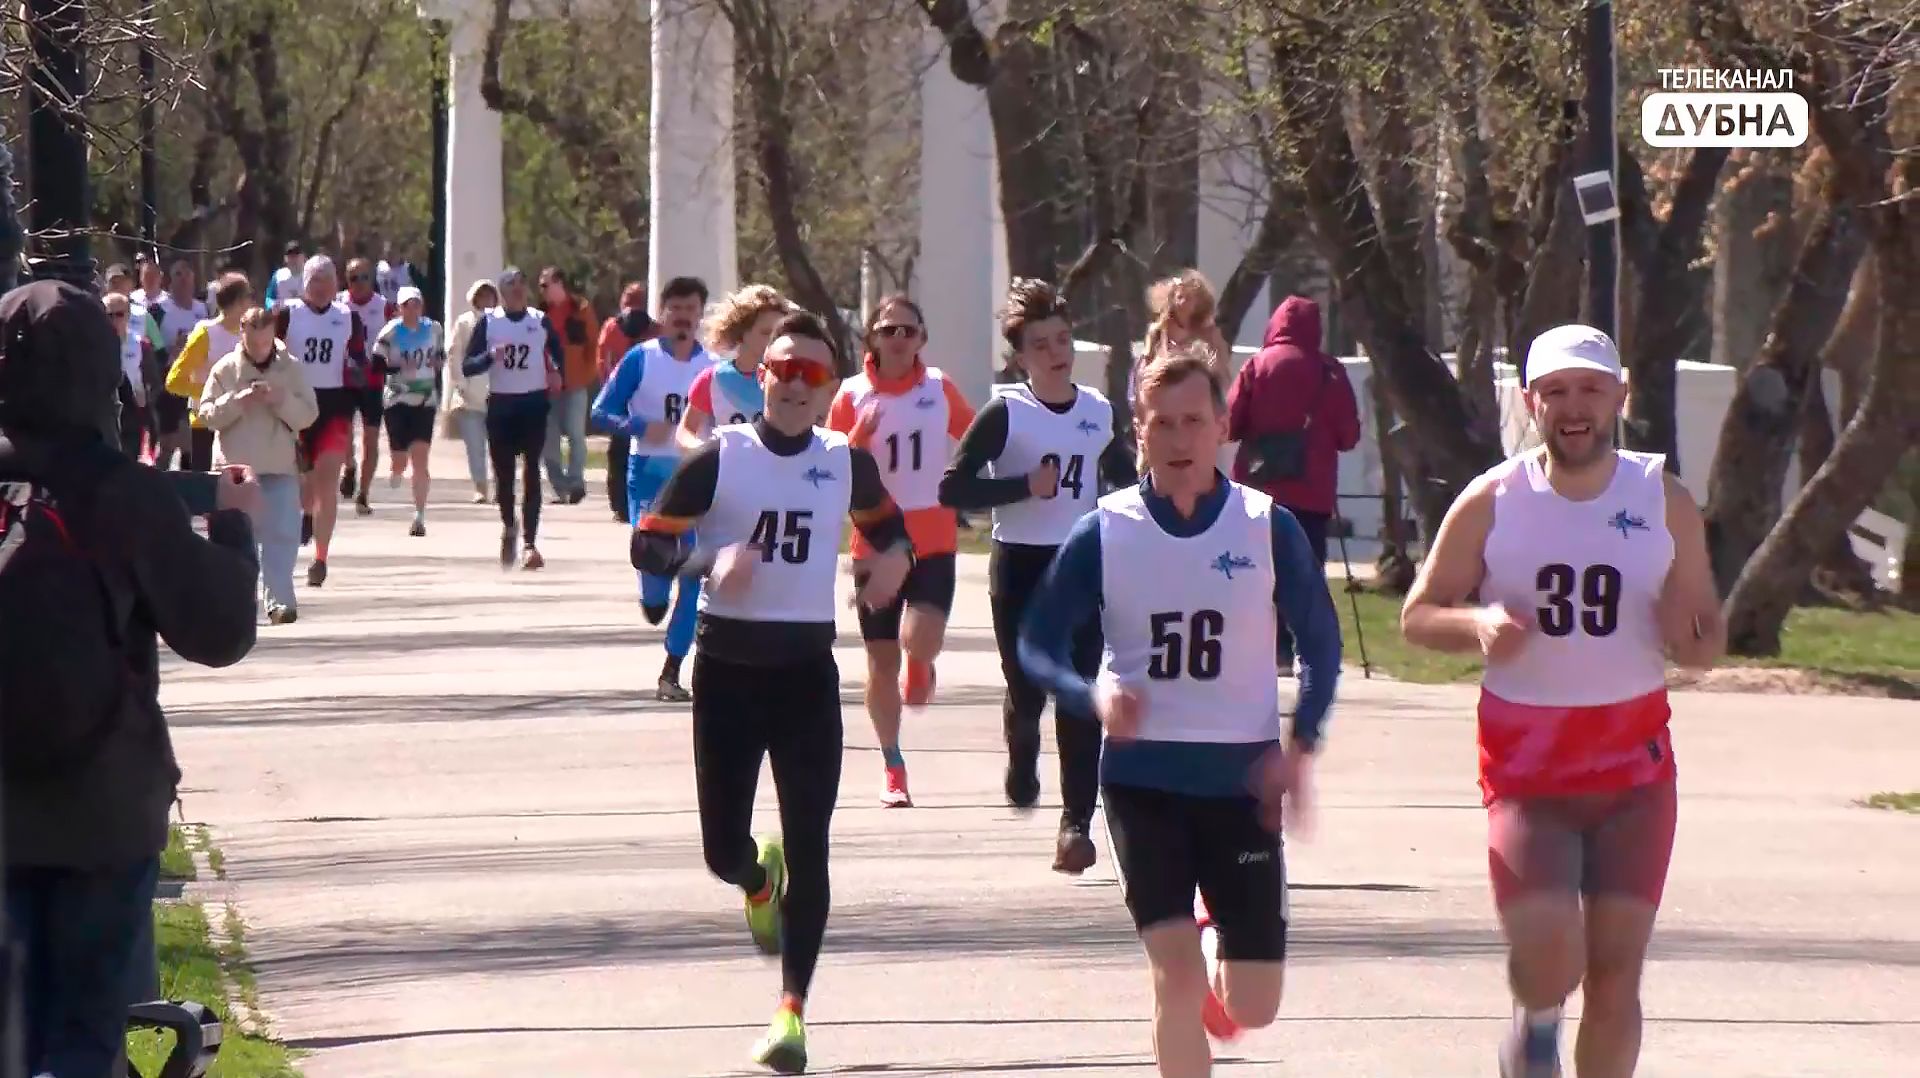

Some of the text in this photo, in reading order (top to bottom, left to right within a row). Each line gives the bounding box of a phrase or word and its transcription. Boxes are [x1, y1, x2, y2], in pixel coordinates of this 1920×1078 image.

[304, 337, 334, 363] 38
[503, 344, 530, 369] 32
[664, 393, 688, 425] 6
[885, 430, 922, 472] 11
[750, 511, 813, 564] 45
[1535, 563, 1622, 637] 39
[1148, 609, 1224, 681] 56
